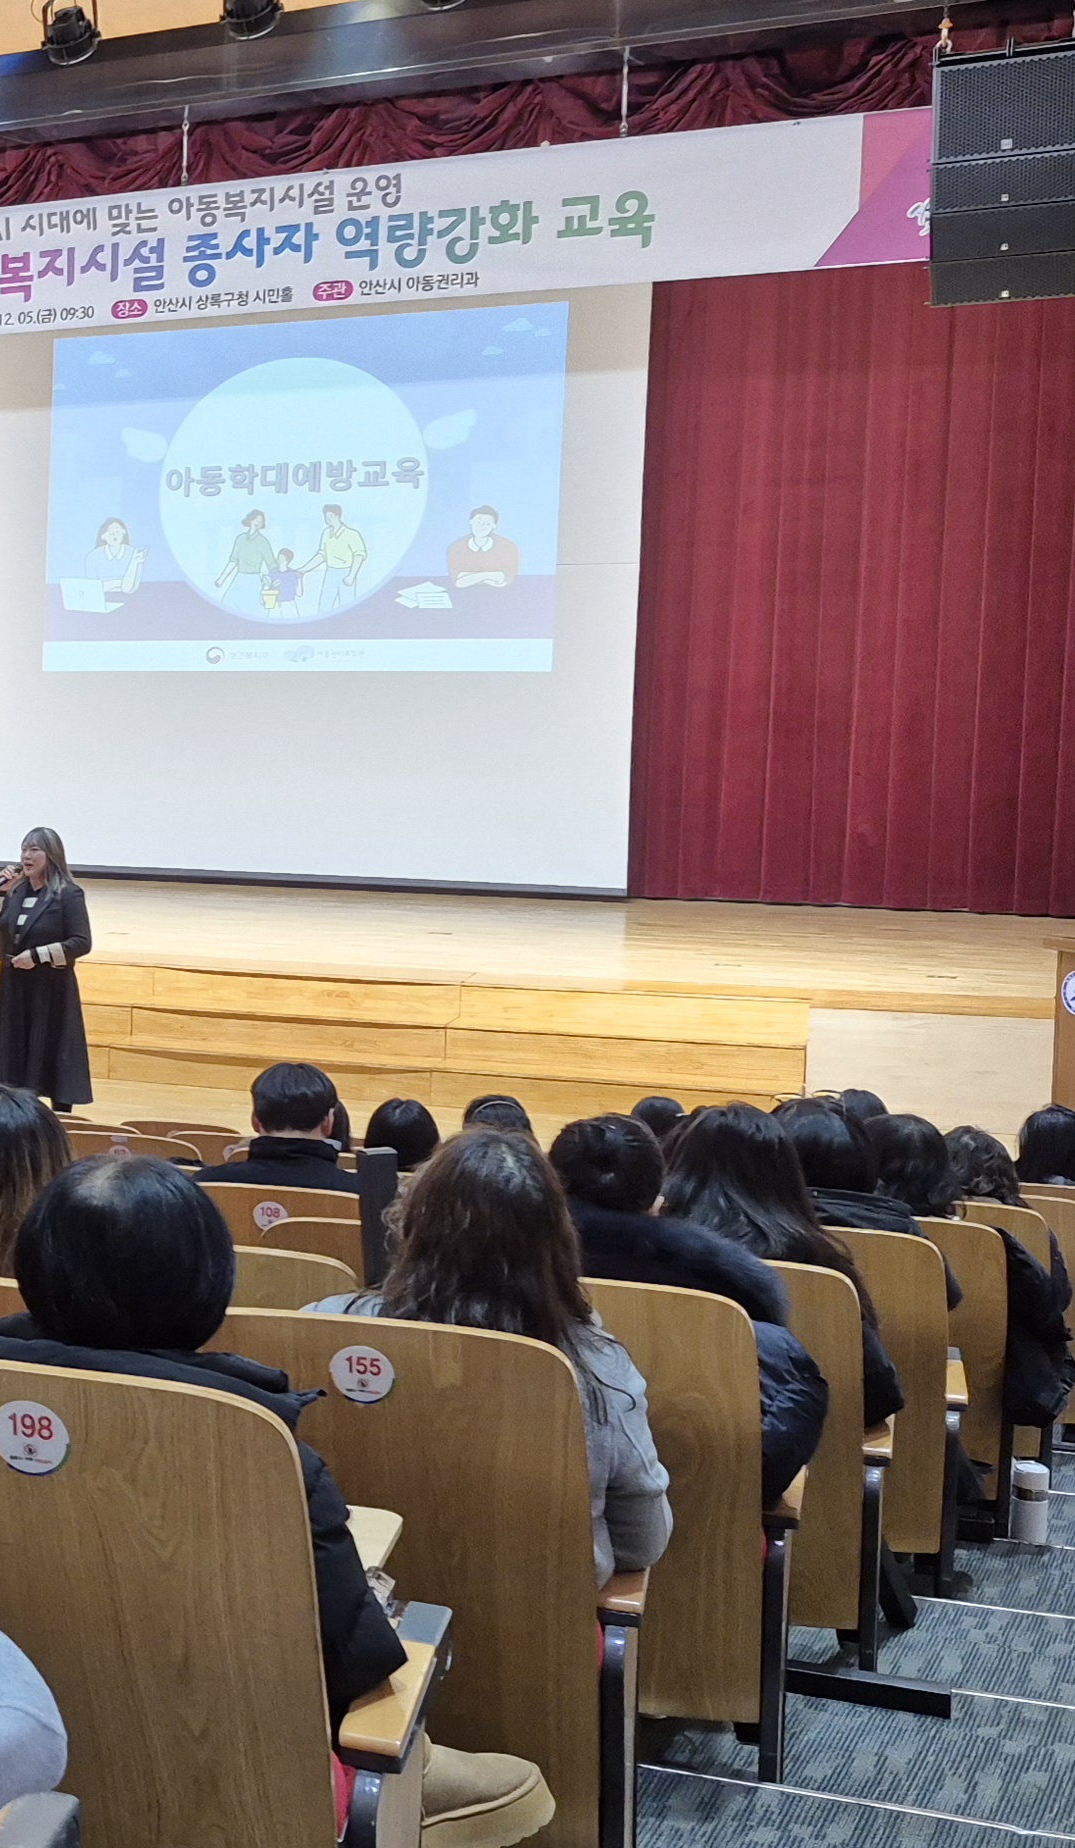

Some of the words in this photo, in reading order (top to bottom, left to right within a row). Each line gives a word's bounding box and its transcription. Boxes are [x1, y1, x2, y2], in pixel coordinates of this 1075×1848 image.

[21, 207, 98, 237] 시대에
[108, 202, 159, 237] 맞는
[168, 179, 336, 228] 아동복지시설
[346, 173, 403, 212] 운영
[182, 221, 320, 288] 종사자
[335, 199, 540, 272] 역량강화
[556, 190, 657, 249] 교육
[60, 305, 96, 322] 09:30
[115, 301, 144, 318] 장소
[154, 295, 193, 314] 안산시
[195, 290, 250, 311] 상록구청
[252, 286, 294, 305] 시민홀
[317, 281, 348, 299] 주관
[358, 277, 403, 297] 안산시
[406, 271, 481, 293] 아동권리과
[165, 456, 425, 498] 아동학대예방교육
[260, 1206, 280, 1219] 108
[345, 1355, 382, 1377] 155
[8, 1412, 54, 1441] 198
